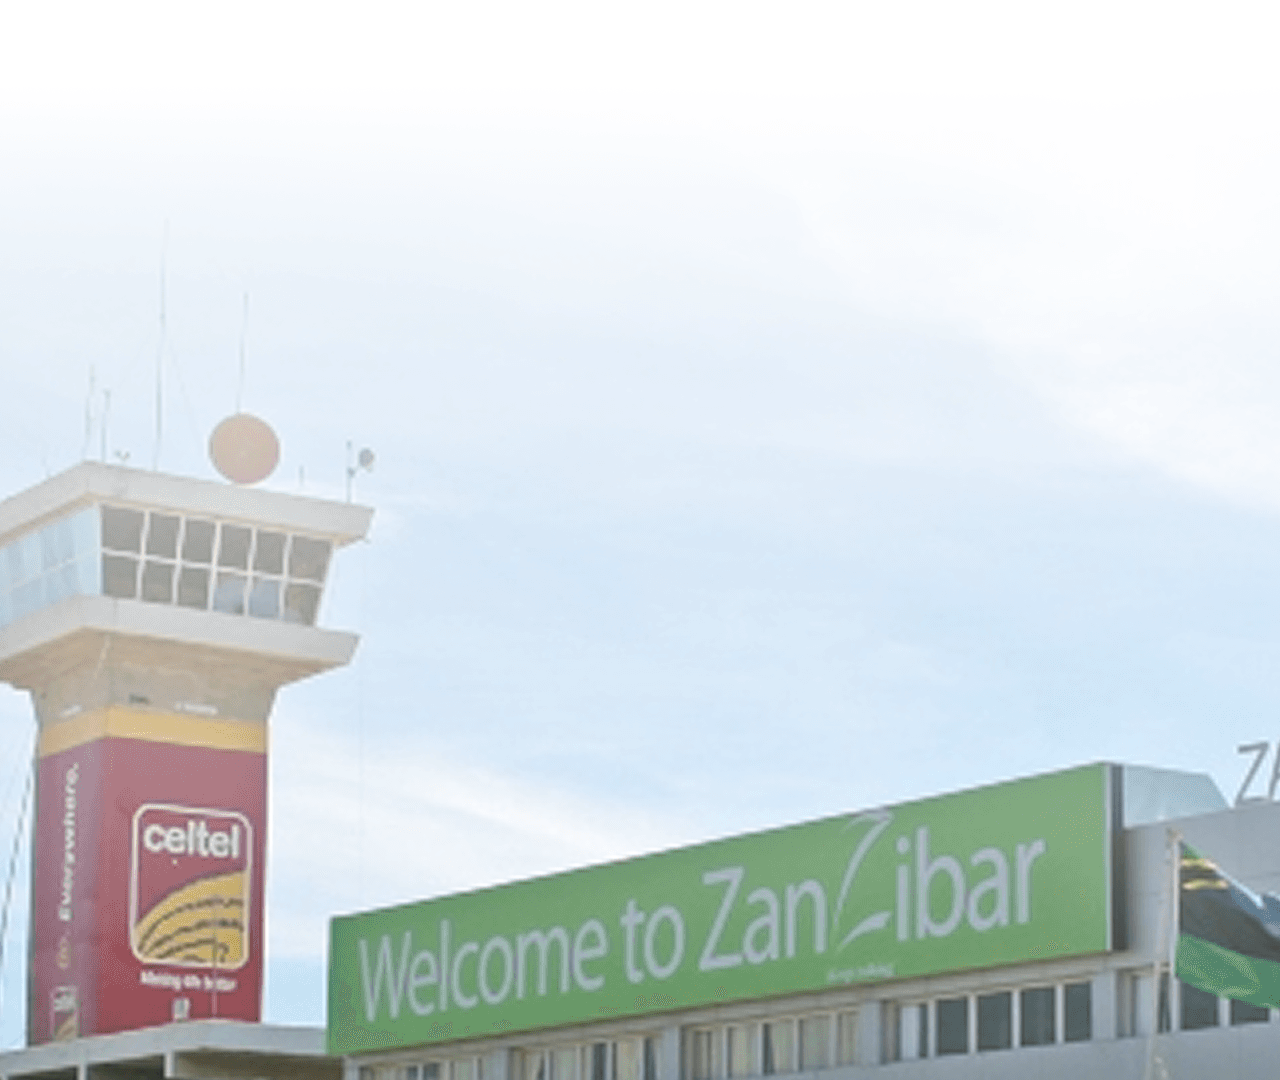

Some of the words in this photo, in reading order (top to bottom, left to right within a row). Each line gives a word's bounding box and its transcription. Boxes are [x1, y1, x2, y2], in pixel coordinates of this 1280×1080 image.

[143, 819, 240, 859] celtel
[358, 917, 608, 1022] Welcome
[621, 899, 686, 984] to
